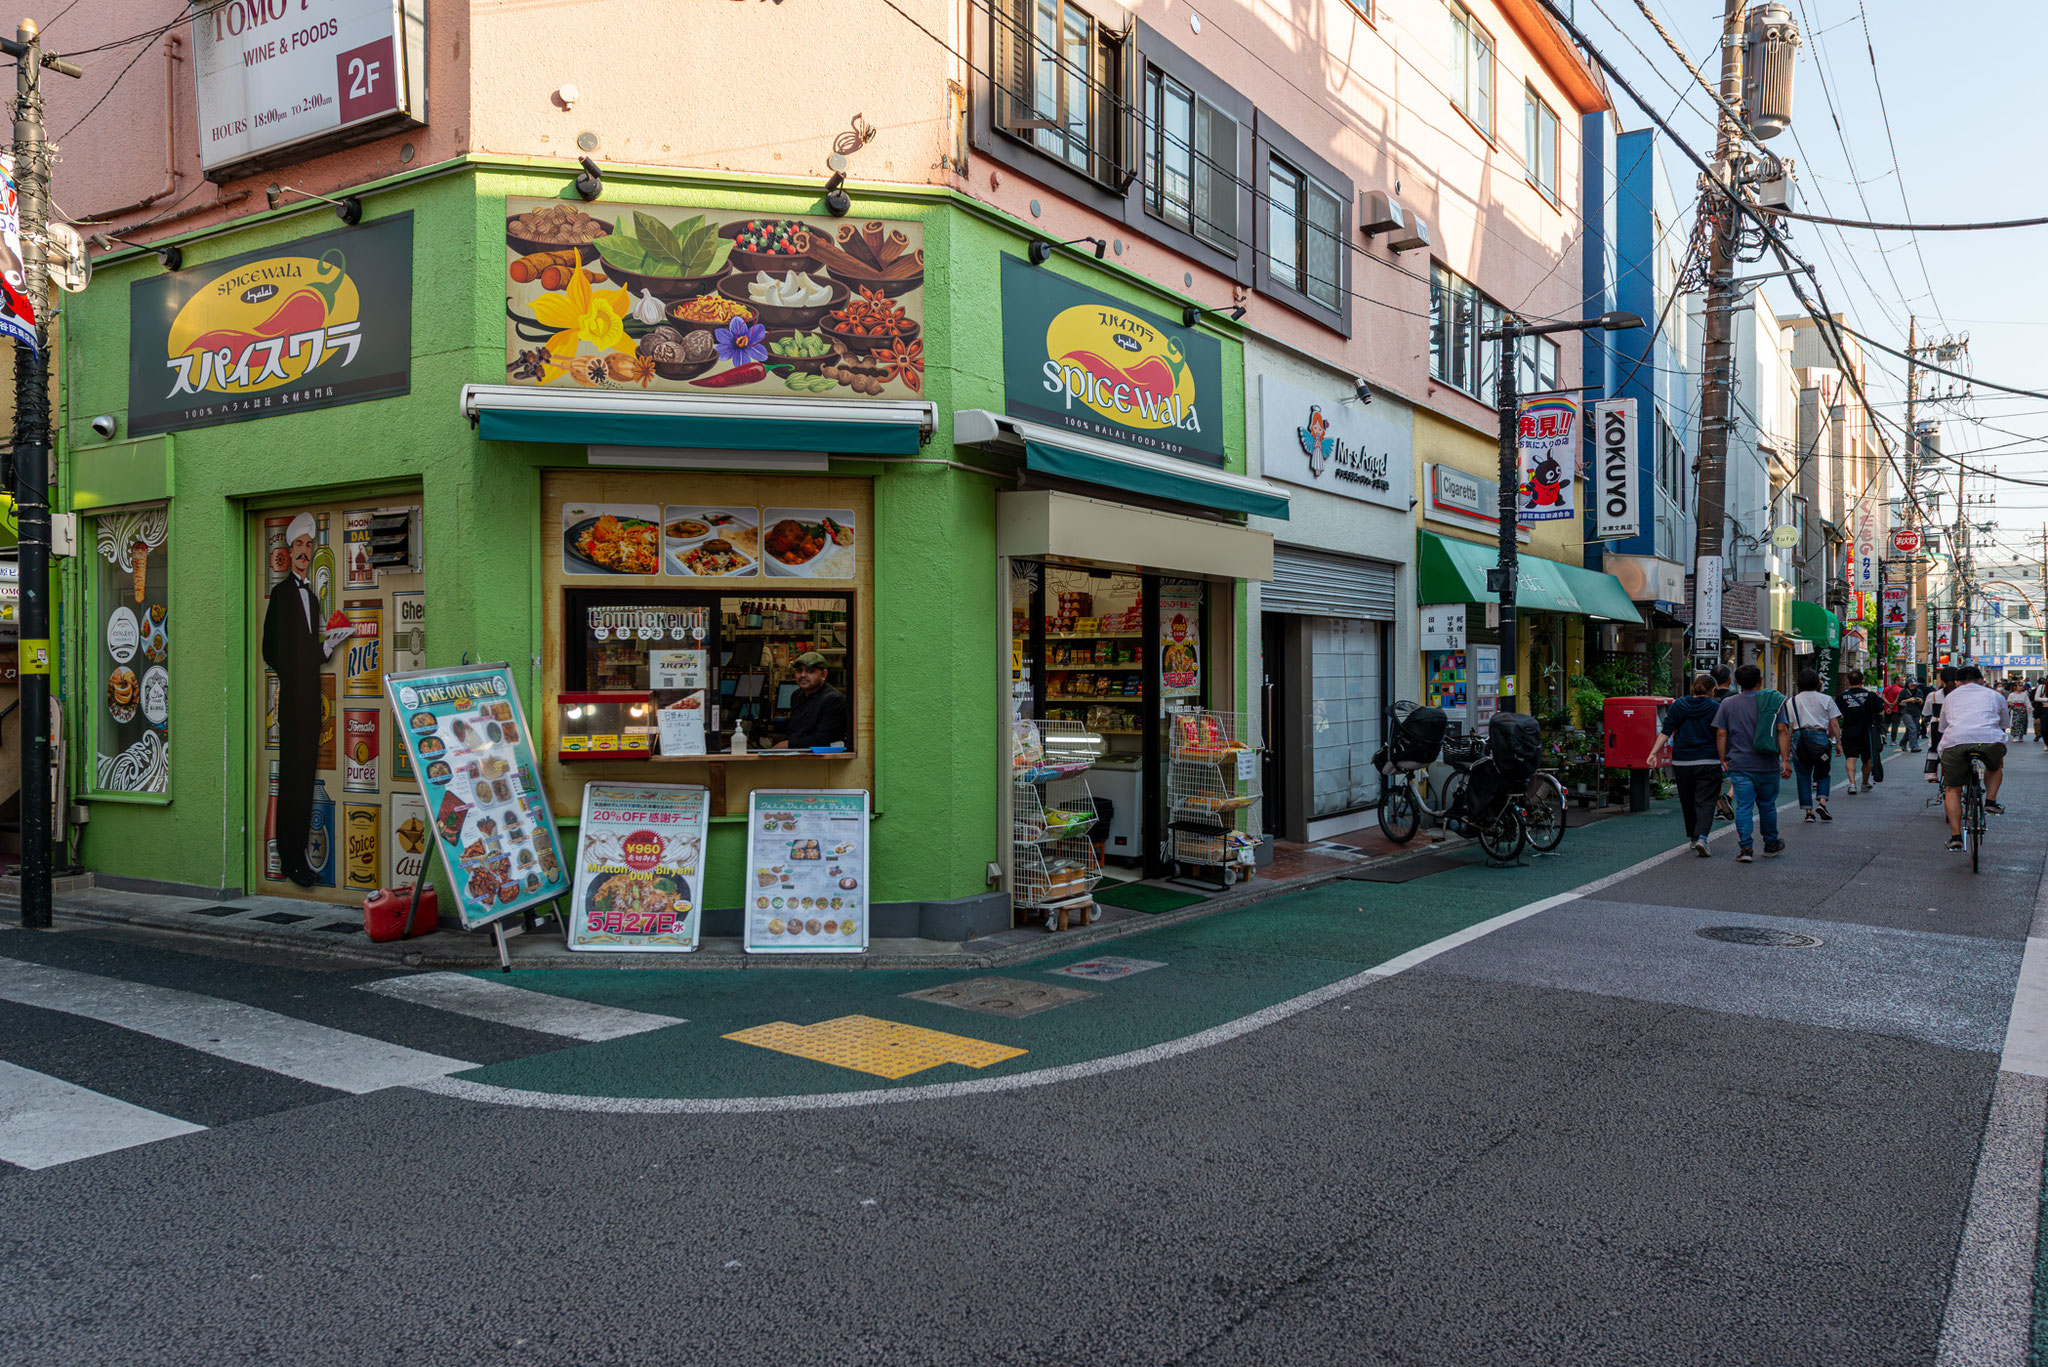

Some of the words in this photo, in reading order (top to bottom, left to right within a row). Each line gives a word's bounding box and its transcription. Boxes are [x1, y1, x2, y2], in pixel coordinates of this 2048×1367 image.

[212, 0, 287, 42] TOMO
[243, 46, 277, 67] WINE
[279, 37, 288, 55] &
[291, 18, 339, 50] FOODS
[348, 57, 381, 100] 2F
[211, 117, 248, 142] HOURS
[253, 107, 288, 129] 18:00pm
[291, 104, 302, 116] TO
[302, 93, 333, 114] 2:00am
[1098, 312, 1154, 343] スパイスワラ
[165, 321, 362, 400] スパイスワラ
[184, 407, 213, 420] 100%
[221, 396, 272, 413] ハラル認証
[281, 386, 334, 405] 食材専門店
[1064, 416, 1089, 431] 100%
[1095, 425, 1126, 440] HALAL
[1132, 433, 1156, 447] FOOD
[1161, 441, 1183, 454] SHOP
[1605, 410, 1627, 518] KOKUYO
[1443, 478, 1477, 502] Cigarette
[351, 532, 370, 542] DAL
[1860, 499, 1876, 556] くだもの
[1896, 536, 1917, 546] 消火栓
[1863, 557, 1872, 580] カワムラ
[1428, 616, 1435, 633] 印紙
[347, 640, 380, 678] RICE
[660, 662, 698, 670] スパイスワラ
[417, 687, 448, 703] TAKE
[445, 684, 467, 699] OUT
[466, 680, 495, 697] MENU
[347, 720, 376, 733] Tomato
[593, 810, 647, 823] 20%OFF
[648, 812, 698, 825] 感謝デー!
[349, 835, 375, 855] Spice
[626, 844, 661, 854] ¥960
[587, 863, 628, 875] Mutton
[629, 872, 653, 881] DUM
[655, 864, 695, 877] Biryani
[587, 911, 677, 934] 5月27日
